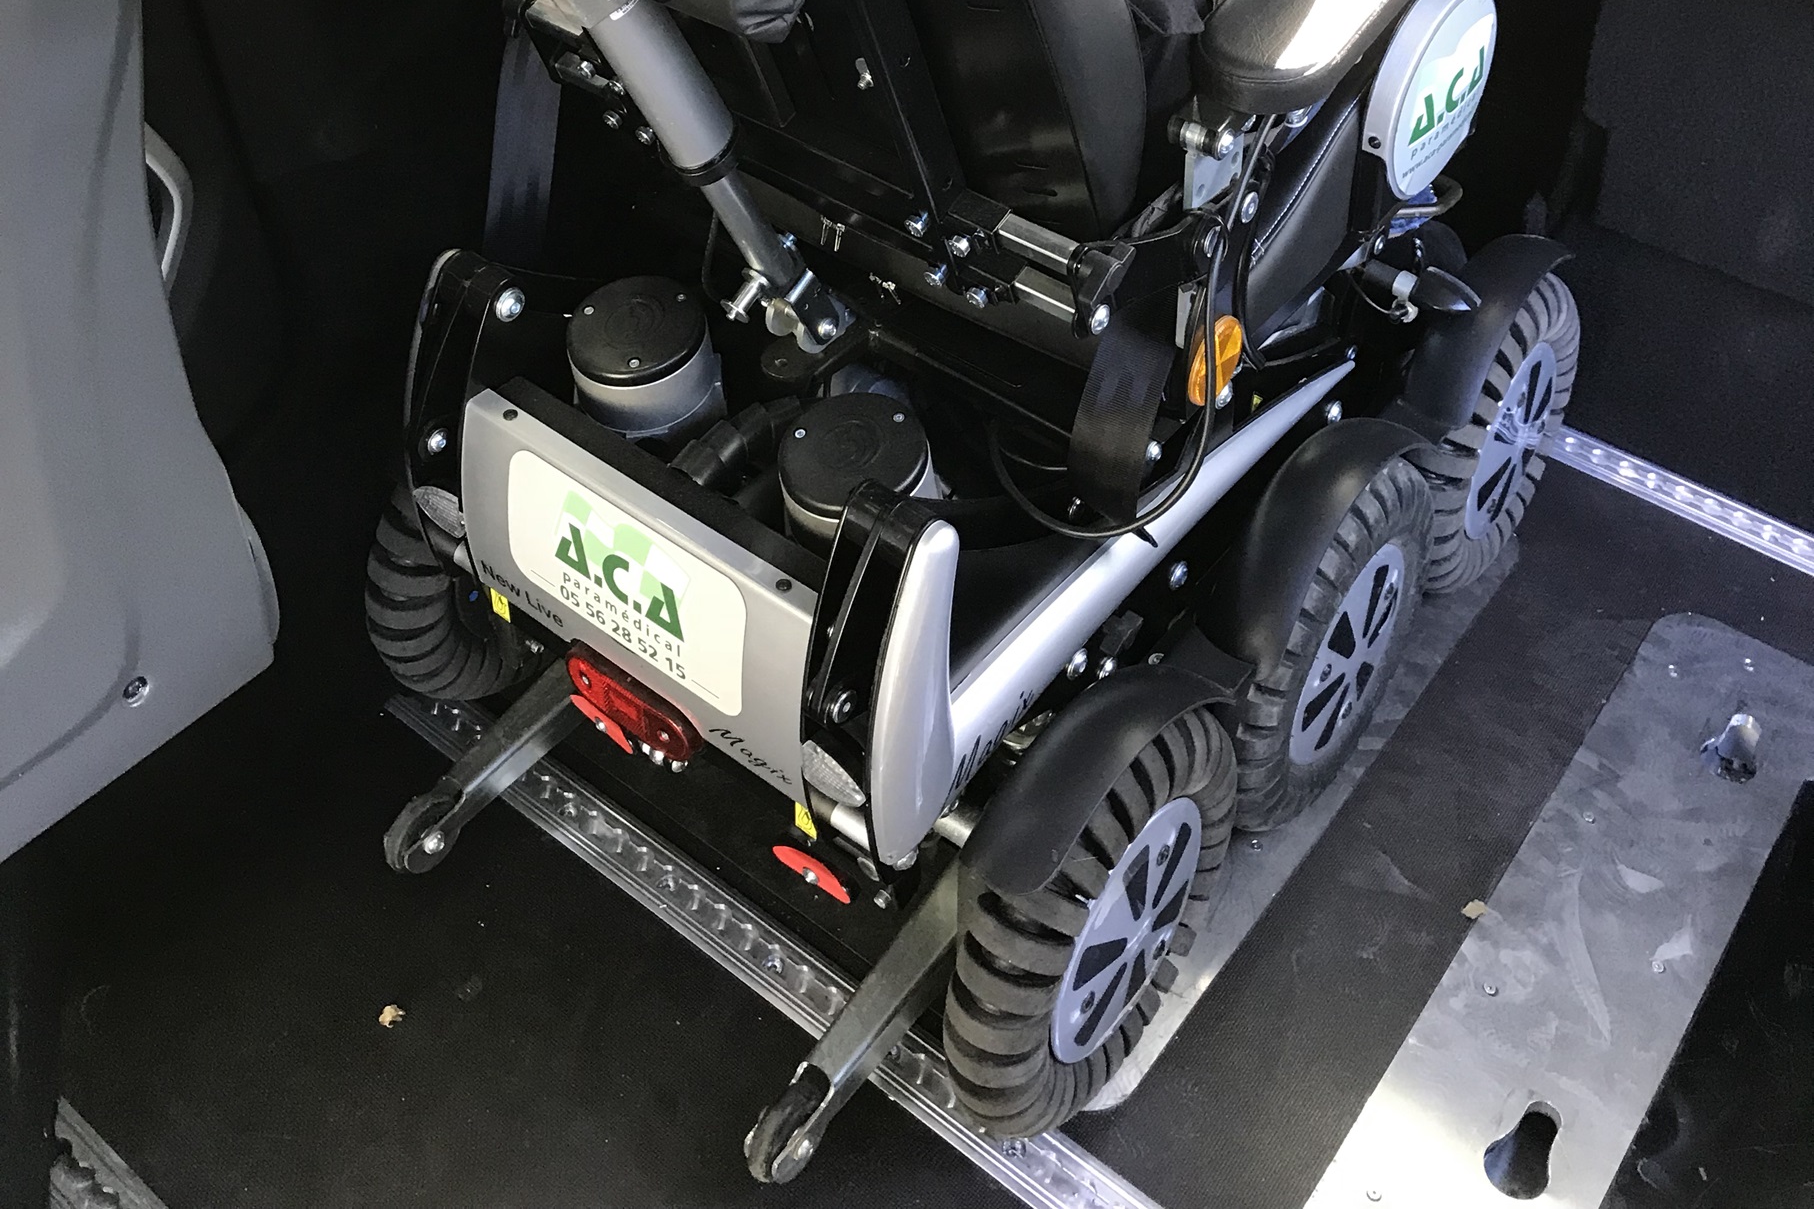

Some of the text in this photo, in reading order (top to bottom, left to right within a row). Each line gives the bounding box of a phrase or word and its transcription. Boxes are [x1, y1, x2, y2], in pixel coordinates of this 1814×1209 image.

[481, 560, 564, 628] New Live
[554, 522, 684, 642] A.C.A
[560, 584, 687, 680] 05 56 28 52 15
[708, 727, 793, 787] Magix
